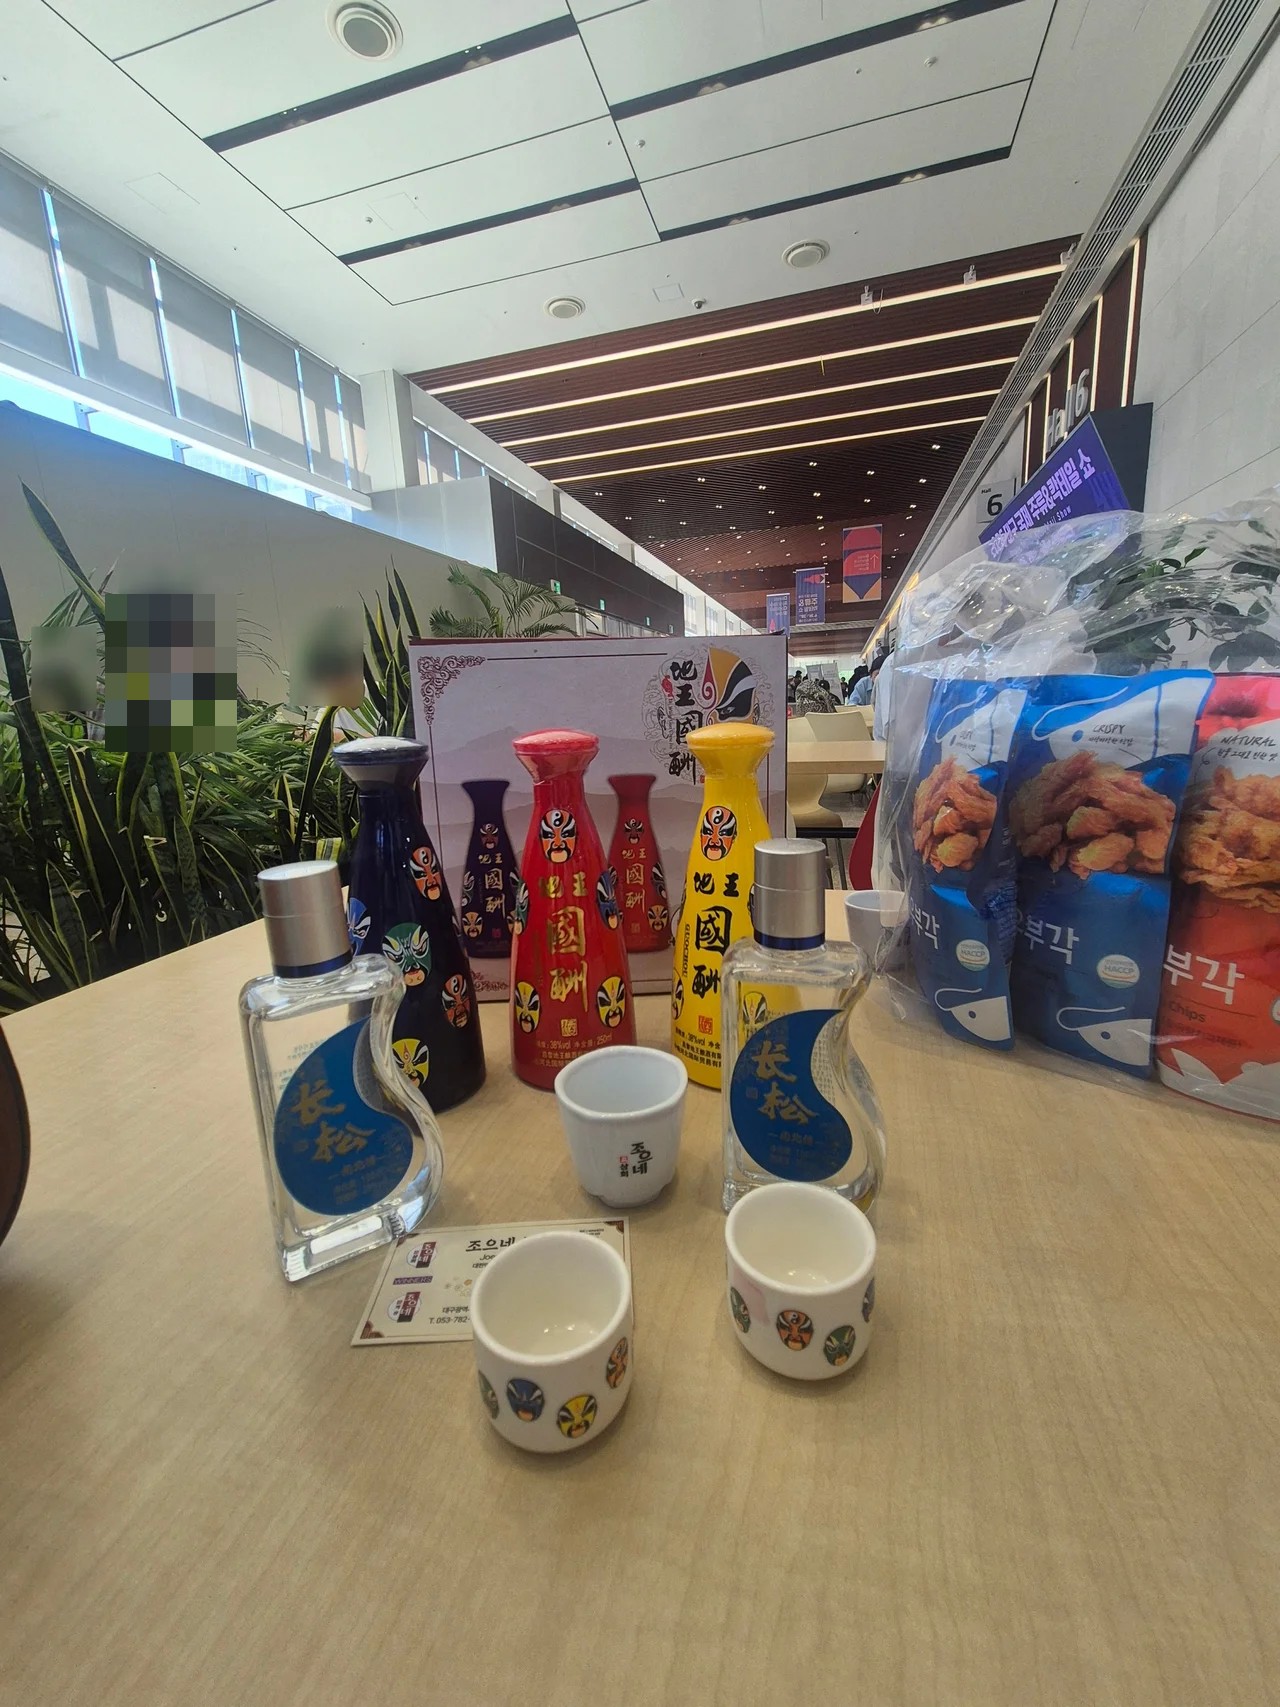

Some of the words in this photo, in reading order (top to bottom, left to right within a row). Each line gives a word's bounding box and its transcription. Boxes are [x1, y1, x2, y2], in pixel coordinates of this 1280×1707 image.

[1075, 368, 1090, 418] 6
[1077, 447, 1096, 480] 쇼
[987, 493, 1003, 517] 6
[1056, 505, 1072, 521] Show
[1093, 723, 1126, 735] CRISPY
[1220, 734, 1277, 747] NATURAL
[910, 896, 940, 950] 부각
[1163, 943, 1246, 1006] 부각
[465, 1236, 516, 1252] 조으네
